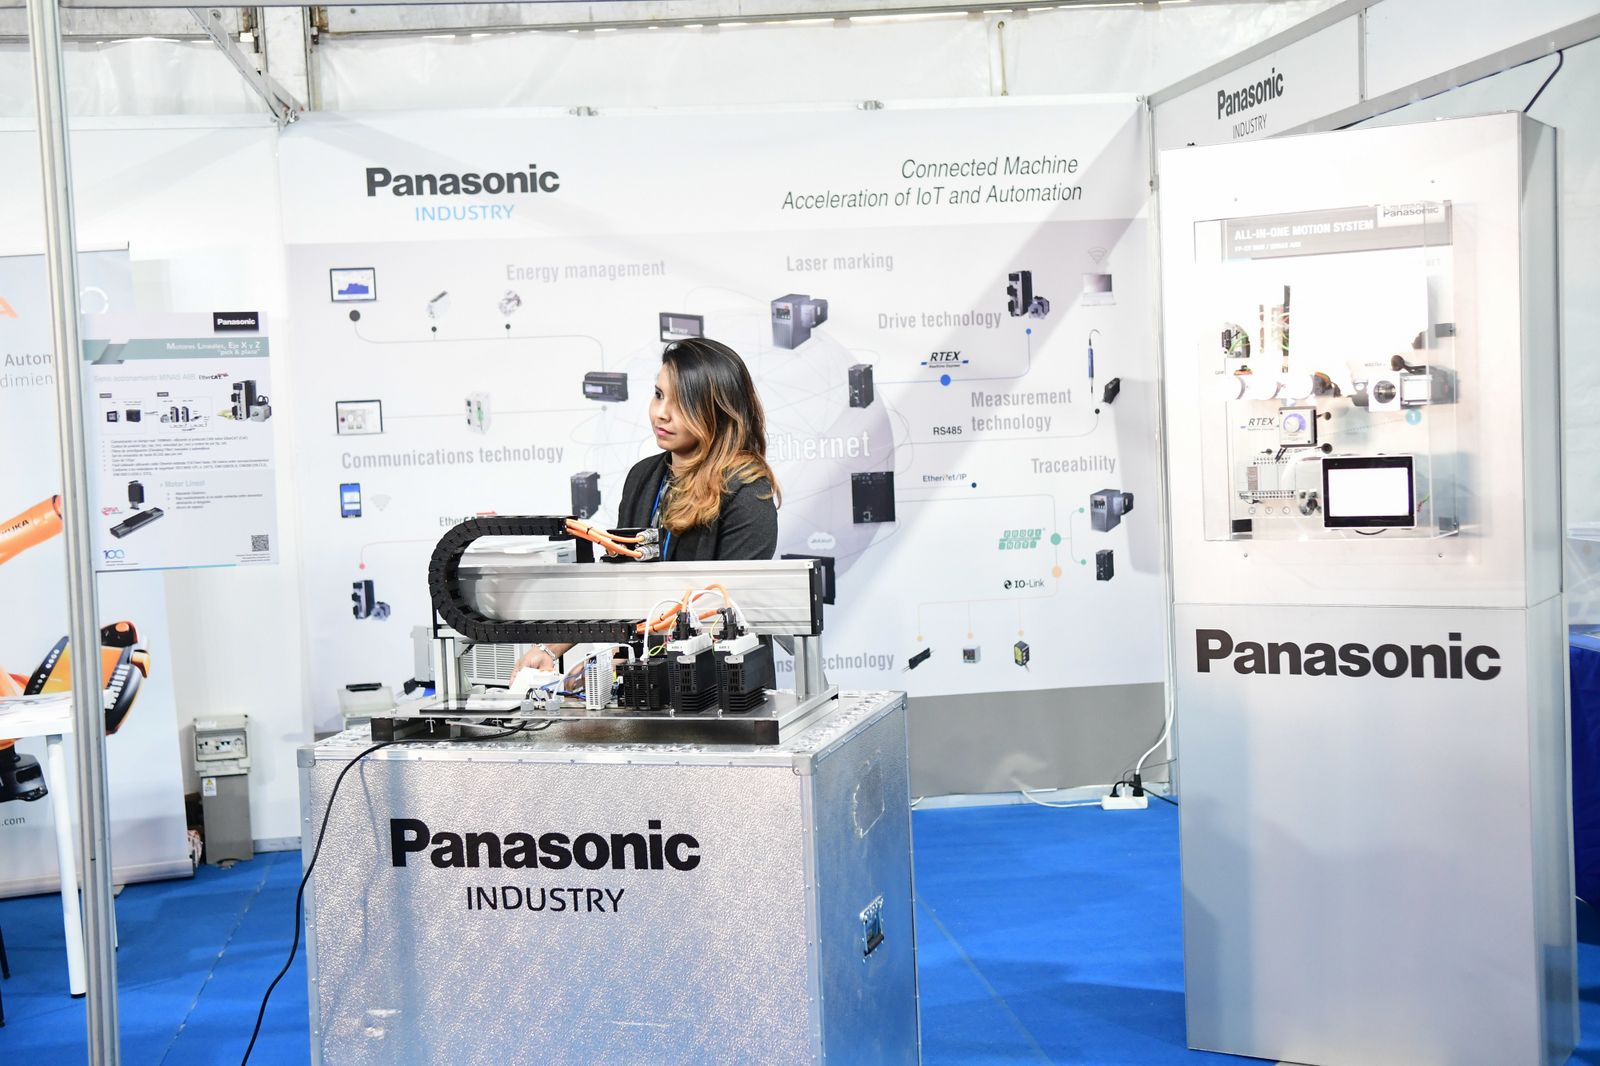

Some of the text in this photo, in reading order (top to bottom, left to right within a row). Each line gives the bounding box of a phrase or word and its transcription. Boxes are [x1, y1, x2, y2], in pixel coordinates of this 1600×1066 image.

[1217, 67, 1284, 120] Panasonic
[1232, 113, 1267, 139] INDUSTRY
[901, 155, 1078, 179] Connected Machine
[366, 163, 560, 197] Panasonic
[782, 182, 1083, 210] Acceleration of IoT and Automation
[415, 204, 515, 221] INDUSTRY
[1383, 207, 1439, 217] Panasonic
[1234, 218, 1374, 241] ALL-IN-ONE MOTION SYSTEM
[506, 260, 667, 284] Energy management
[786, 252, 894, 272] Laser marking
[217, 318, 256, 326] Panasonic
[878, 310, 1002, 330] Drive technology
[930, 351, 961, 362] RTEX
[971, 388, 1072, 408] Measurement
[932, 426, 963, 436] RS485
[971, 414, 1052, 433] technology
[1248, 417, 1275, 426] RTEX
[341, 444, 564, 470] Communications technology
[1031, 456, 1116, 474] Traceability
[439, 517, 477, 528] Ether
[1014, 579, 1045, 588] IO-Link
[821, 652, 895, 673] echnology
[1195, 628, 1502, 681] Panasonic
[390, 818, 701, 871] Panasonic
[466, 885, 625, 913] INDUSTRY
